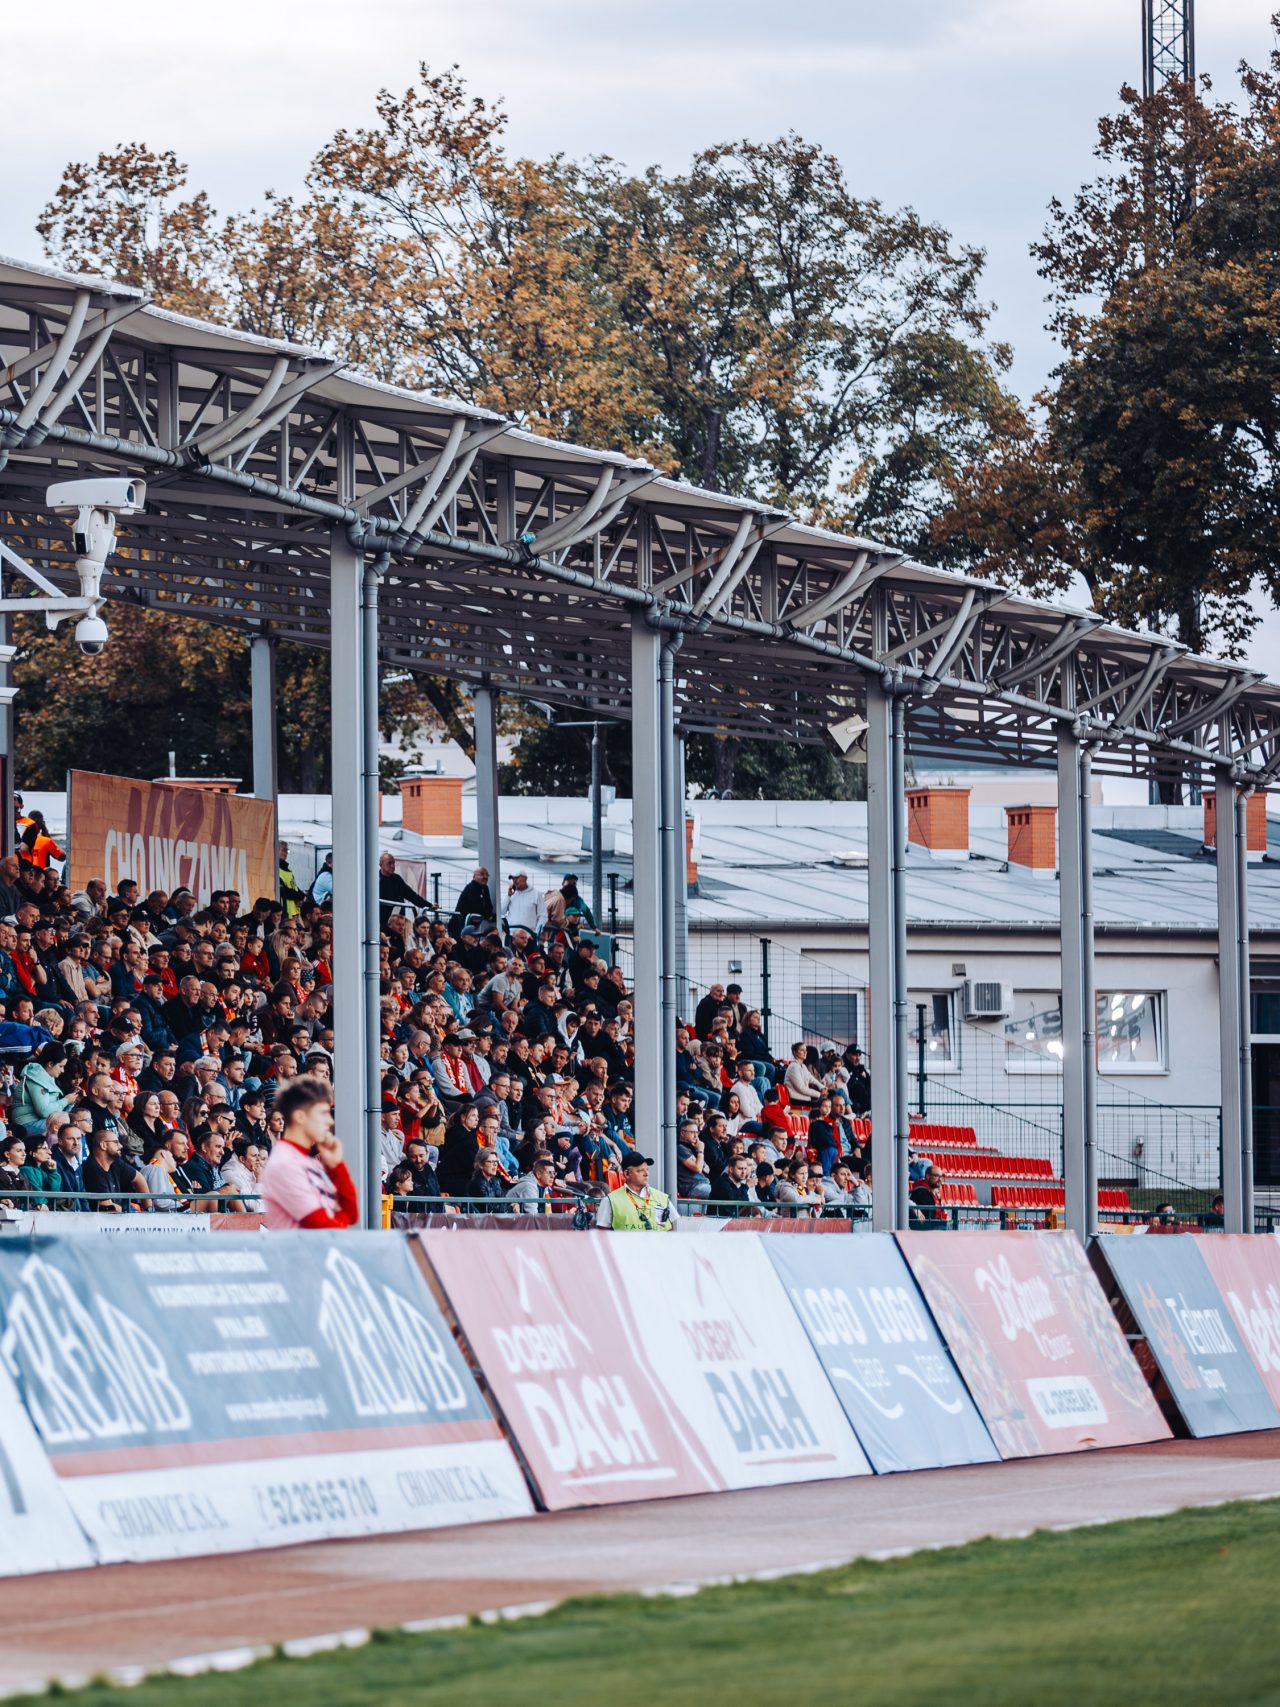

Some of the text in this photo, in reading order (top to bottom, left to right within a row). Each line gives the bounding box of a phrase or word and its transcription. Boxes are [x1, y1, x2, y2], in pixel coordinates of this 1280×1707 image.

[492, 1323, 577, 1374] DOBRY
[791, 1286, 928, 1345] LOGO LOGO
[516, 1375, 659, 1473] DACH
[704, 1367, 821, 1453] DACH
